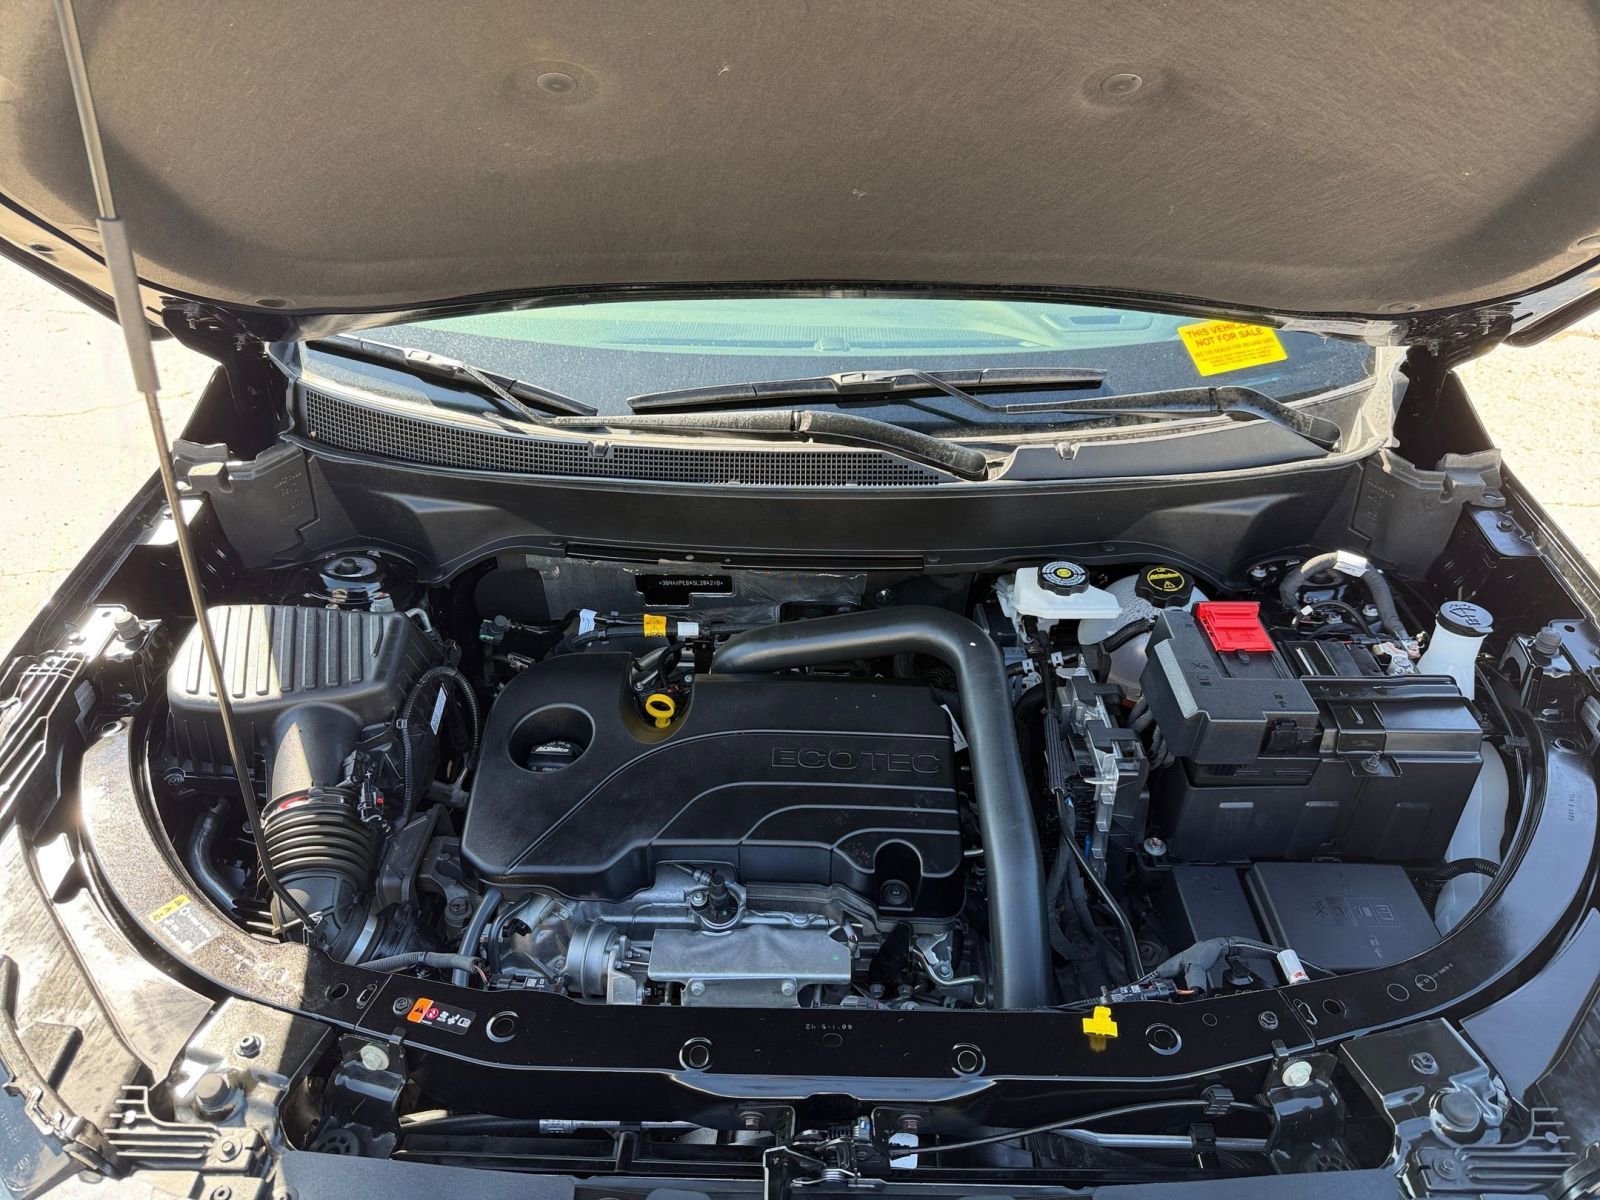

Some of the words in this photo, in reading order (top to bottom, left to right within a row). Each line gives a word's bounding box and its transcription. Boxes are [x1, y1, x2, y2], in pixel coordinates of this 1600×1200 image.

[1185, 328, 1210, 339] THIS
[1210, 323, 1252, 334] VEHICL
[1194, 336, 1216, 348] NOT
[1216, 333, 1238, 344] FOR
[1238, 327, 1264, 339] SALE
[535, 745, 569, 753] ACDelco
